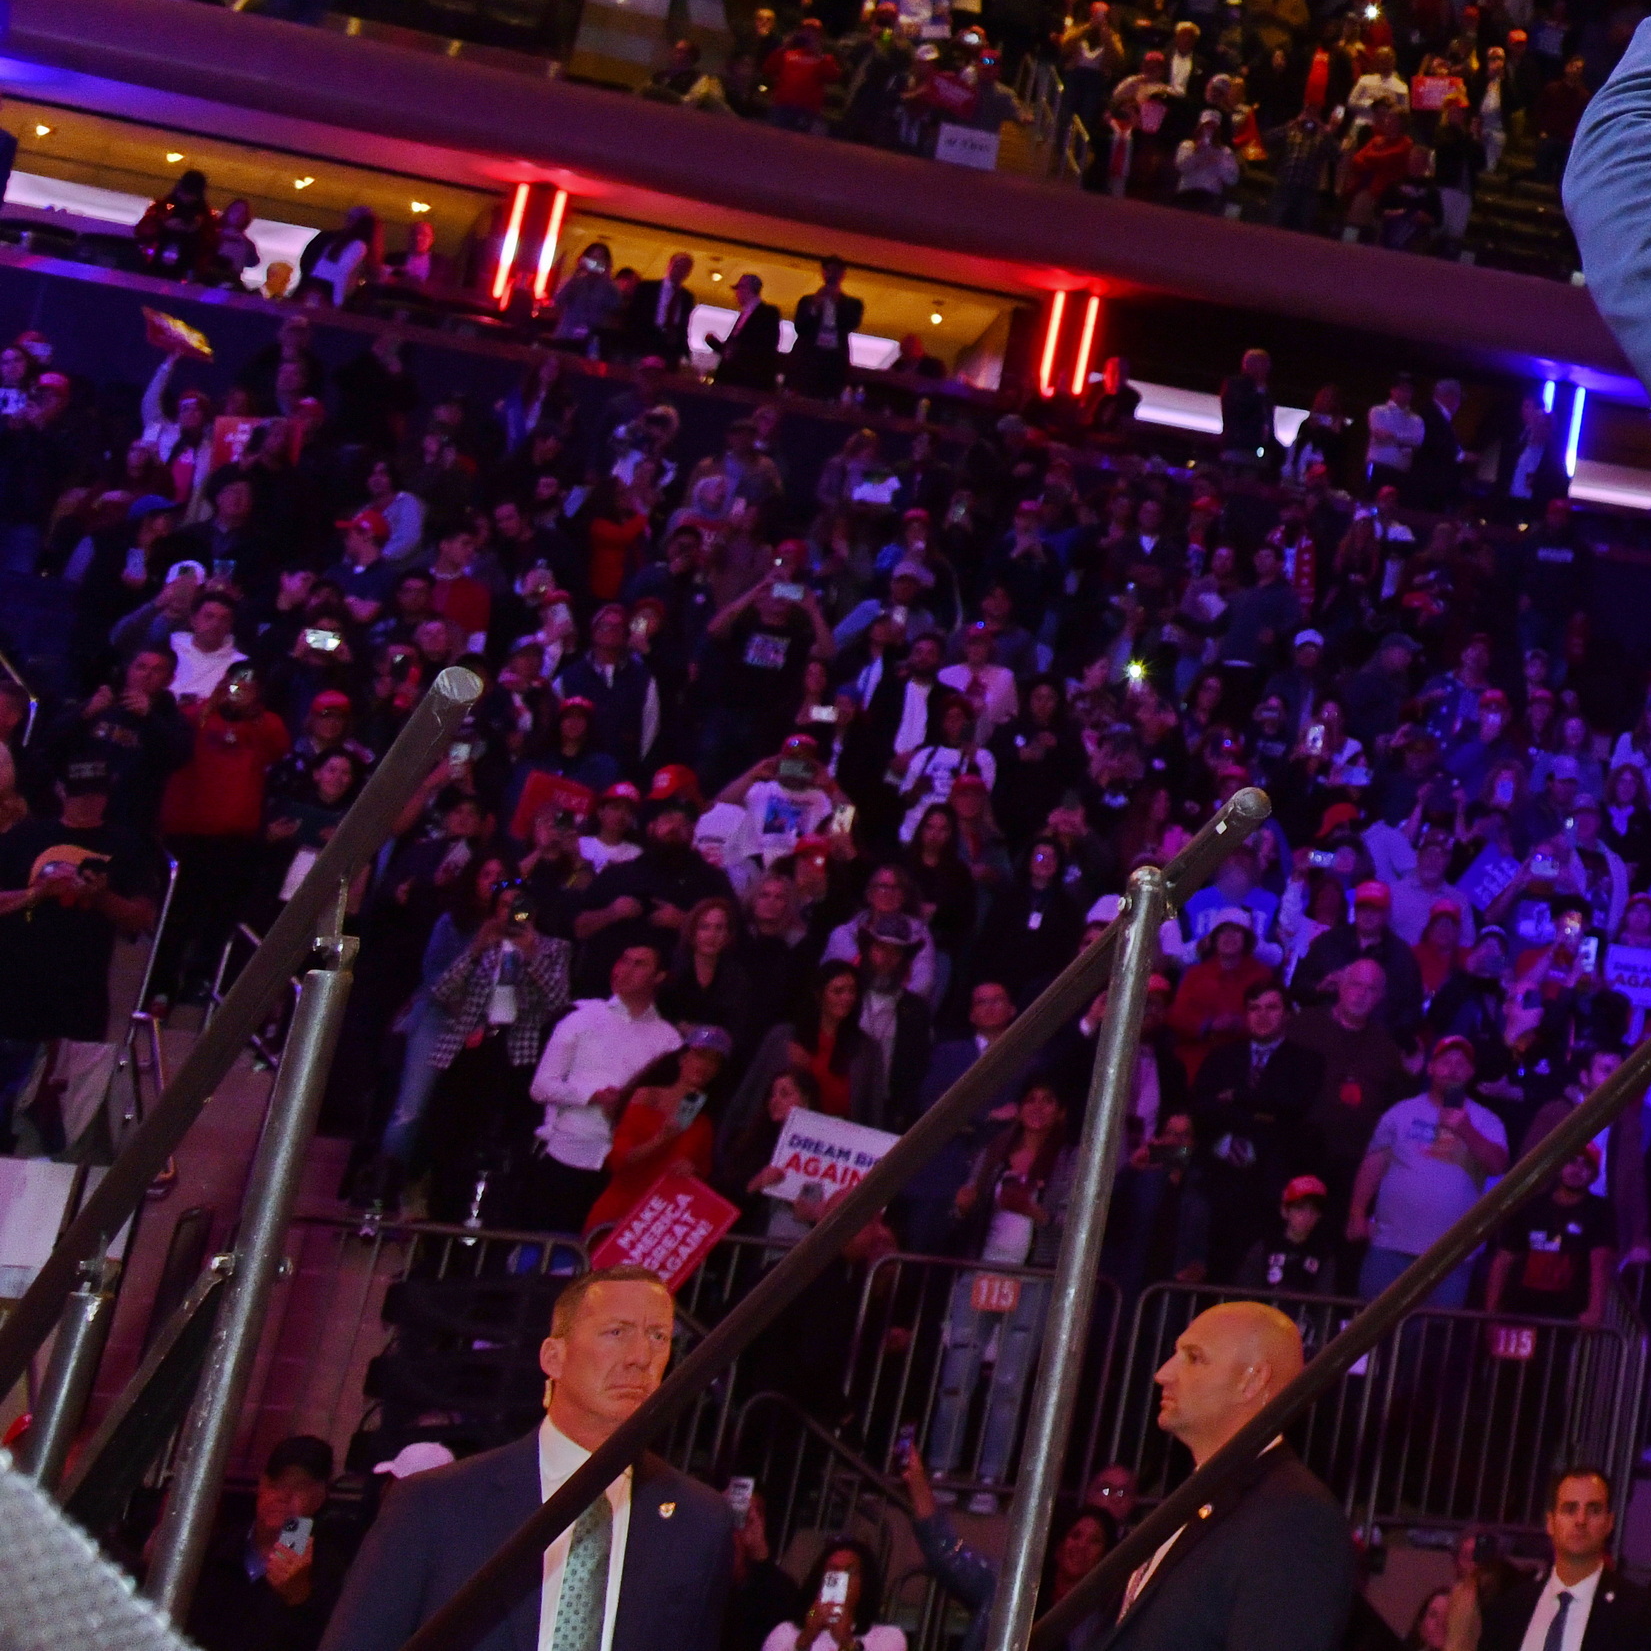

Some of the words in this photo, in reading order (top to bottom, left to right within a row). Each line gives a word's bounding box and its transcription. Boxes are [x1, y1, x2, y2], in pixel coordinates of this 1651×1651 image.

[788, 1134, 852, 1162] DREAM
[855, 1151, 881, 1169] BI
[616, 1195, 668, 1249] MAKE
[979, 1278, 1014, 1307] 115
[1498, 1328, 1532, 1356] 115
